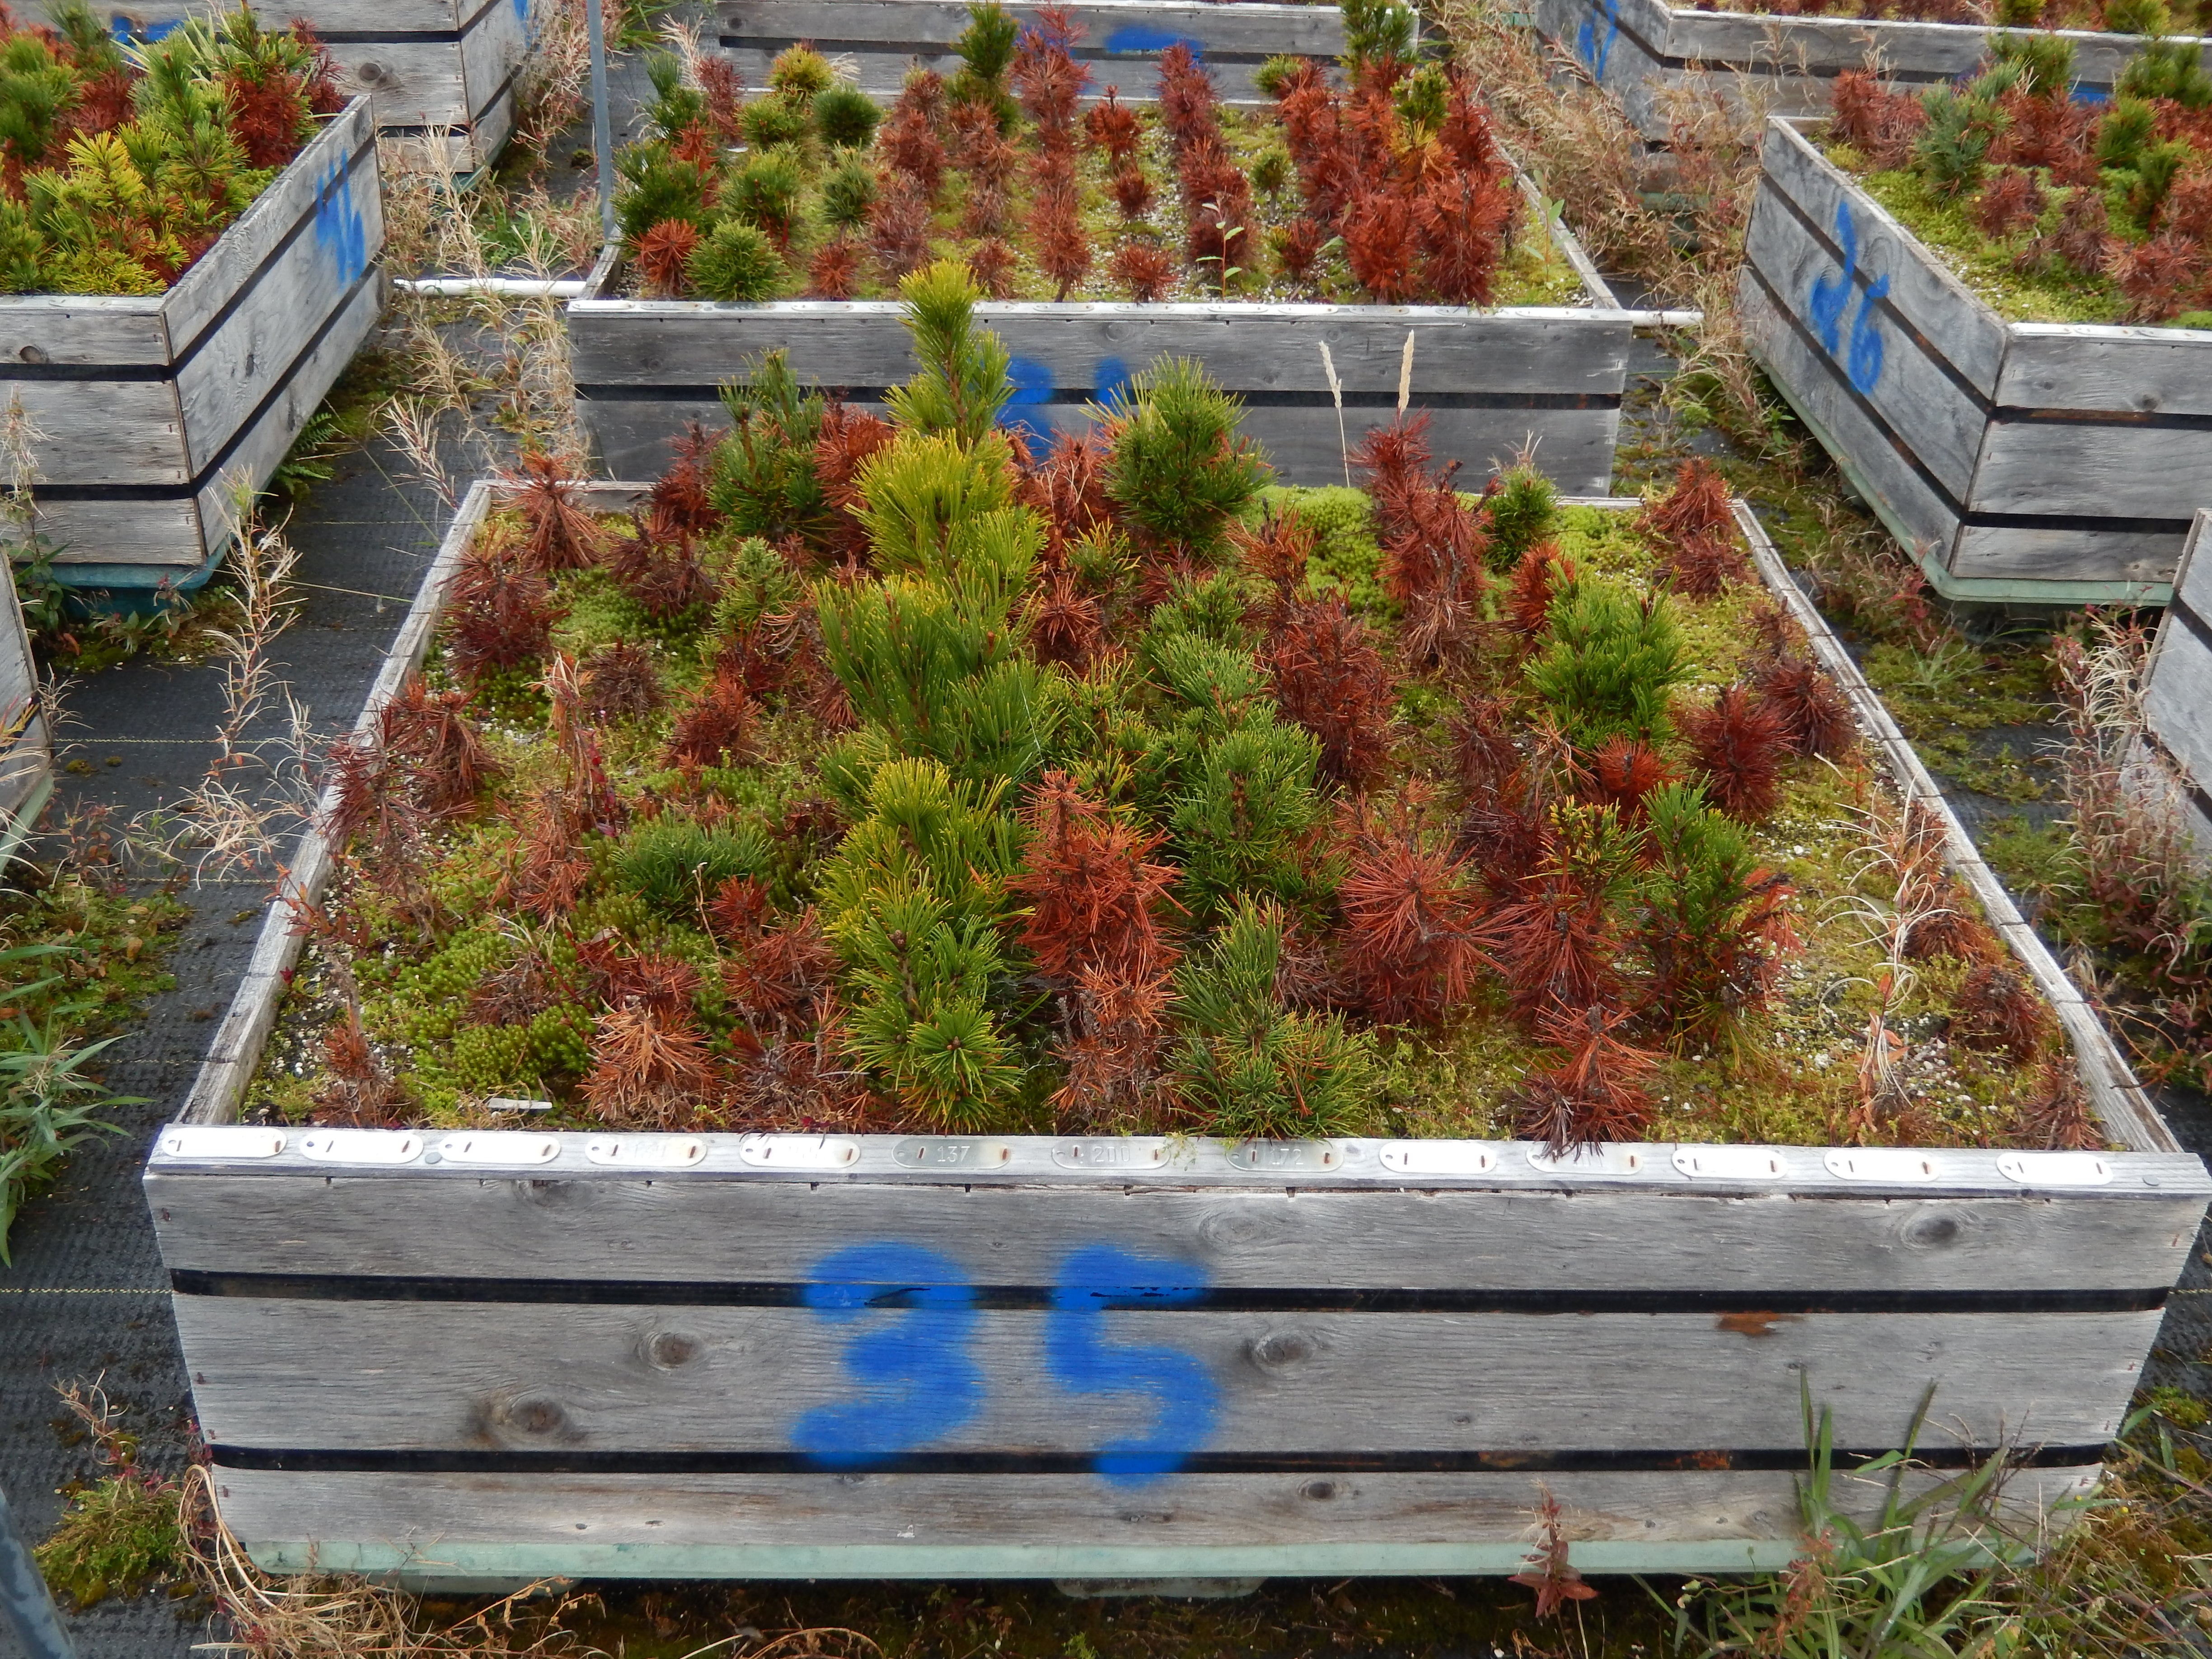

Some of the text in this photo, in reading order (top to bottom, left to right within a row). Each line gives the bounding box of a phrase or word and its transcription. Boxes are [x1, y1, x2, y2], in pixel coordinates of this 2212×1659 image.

[1811, 201, 1889, 395] 26
[936, 1145, 971, 1162] 137
[1093, 1146, 1131, 1162] 200
[1270, 1148, 1304, 1165] 172
[792, 1241, 1221, 1490] 35
